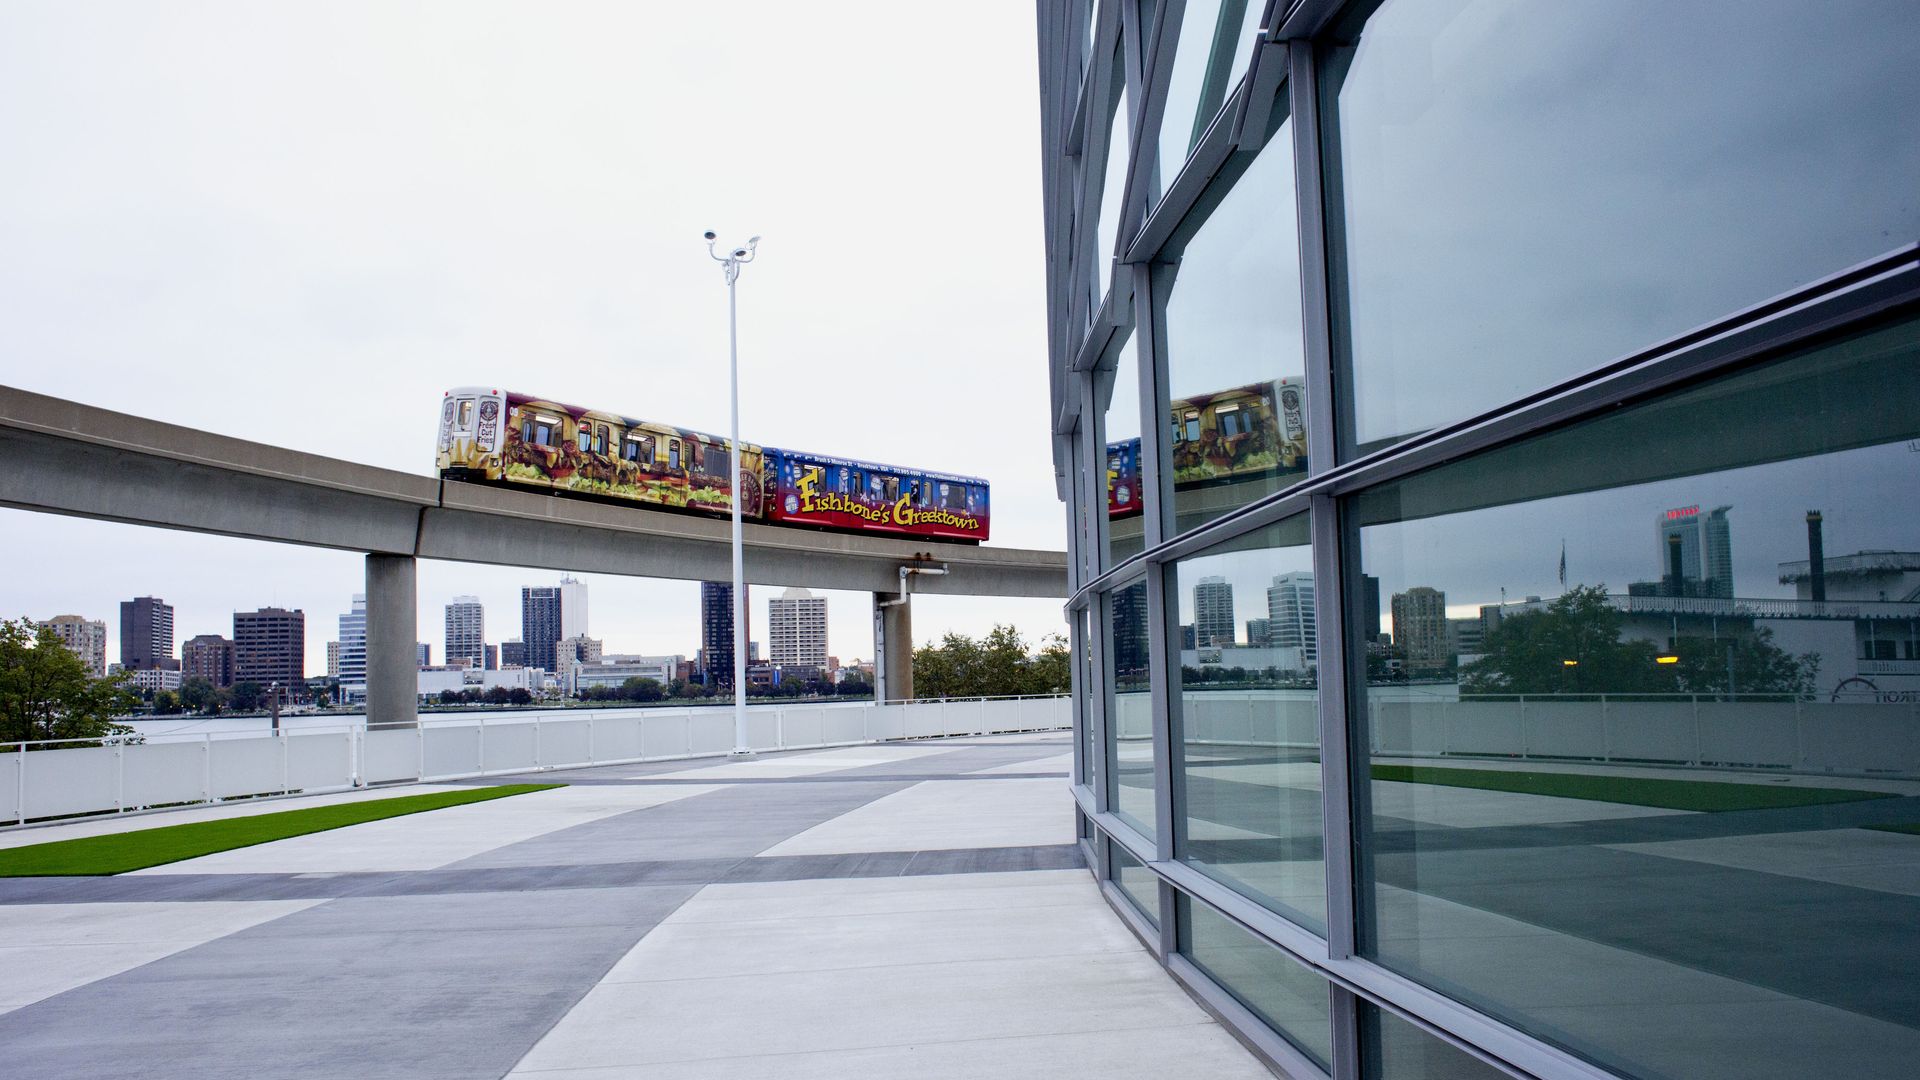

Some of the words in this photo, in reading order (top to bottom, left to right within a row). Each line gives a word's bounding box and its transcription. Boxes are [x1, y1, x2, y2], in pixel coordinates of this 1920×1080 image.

[481, 428, 493, 436] Cut
[796, 468, 890, 524] Fishbone's
[893, 492, 979, 530] Greektown
